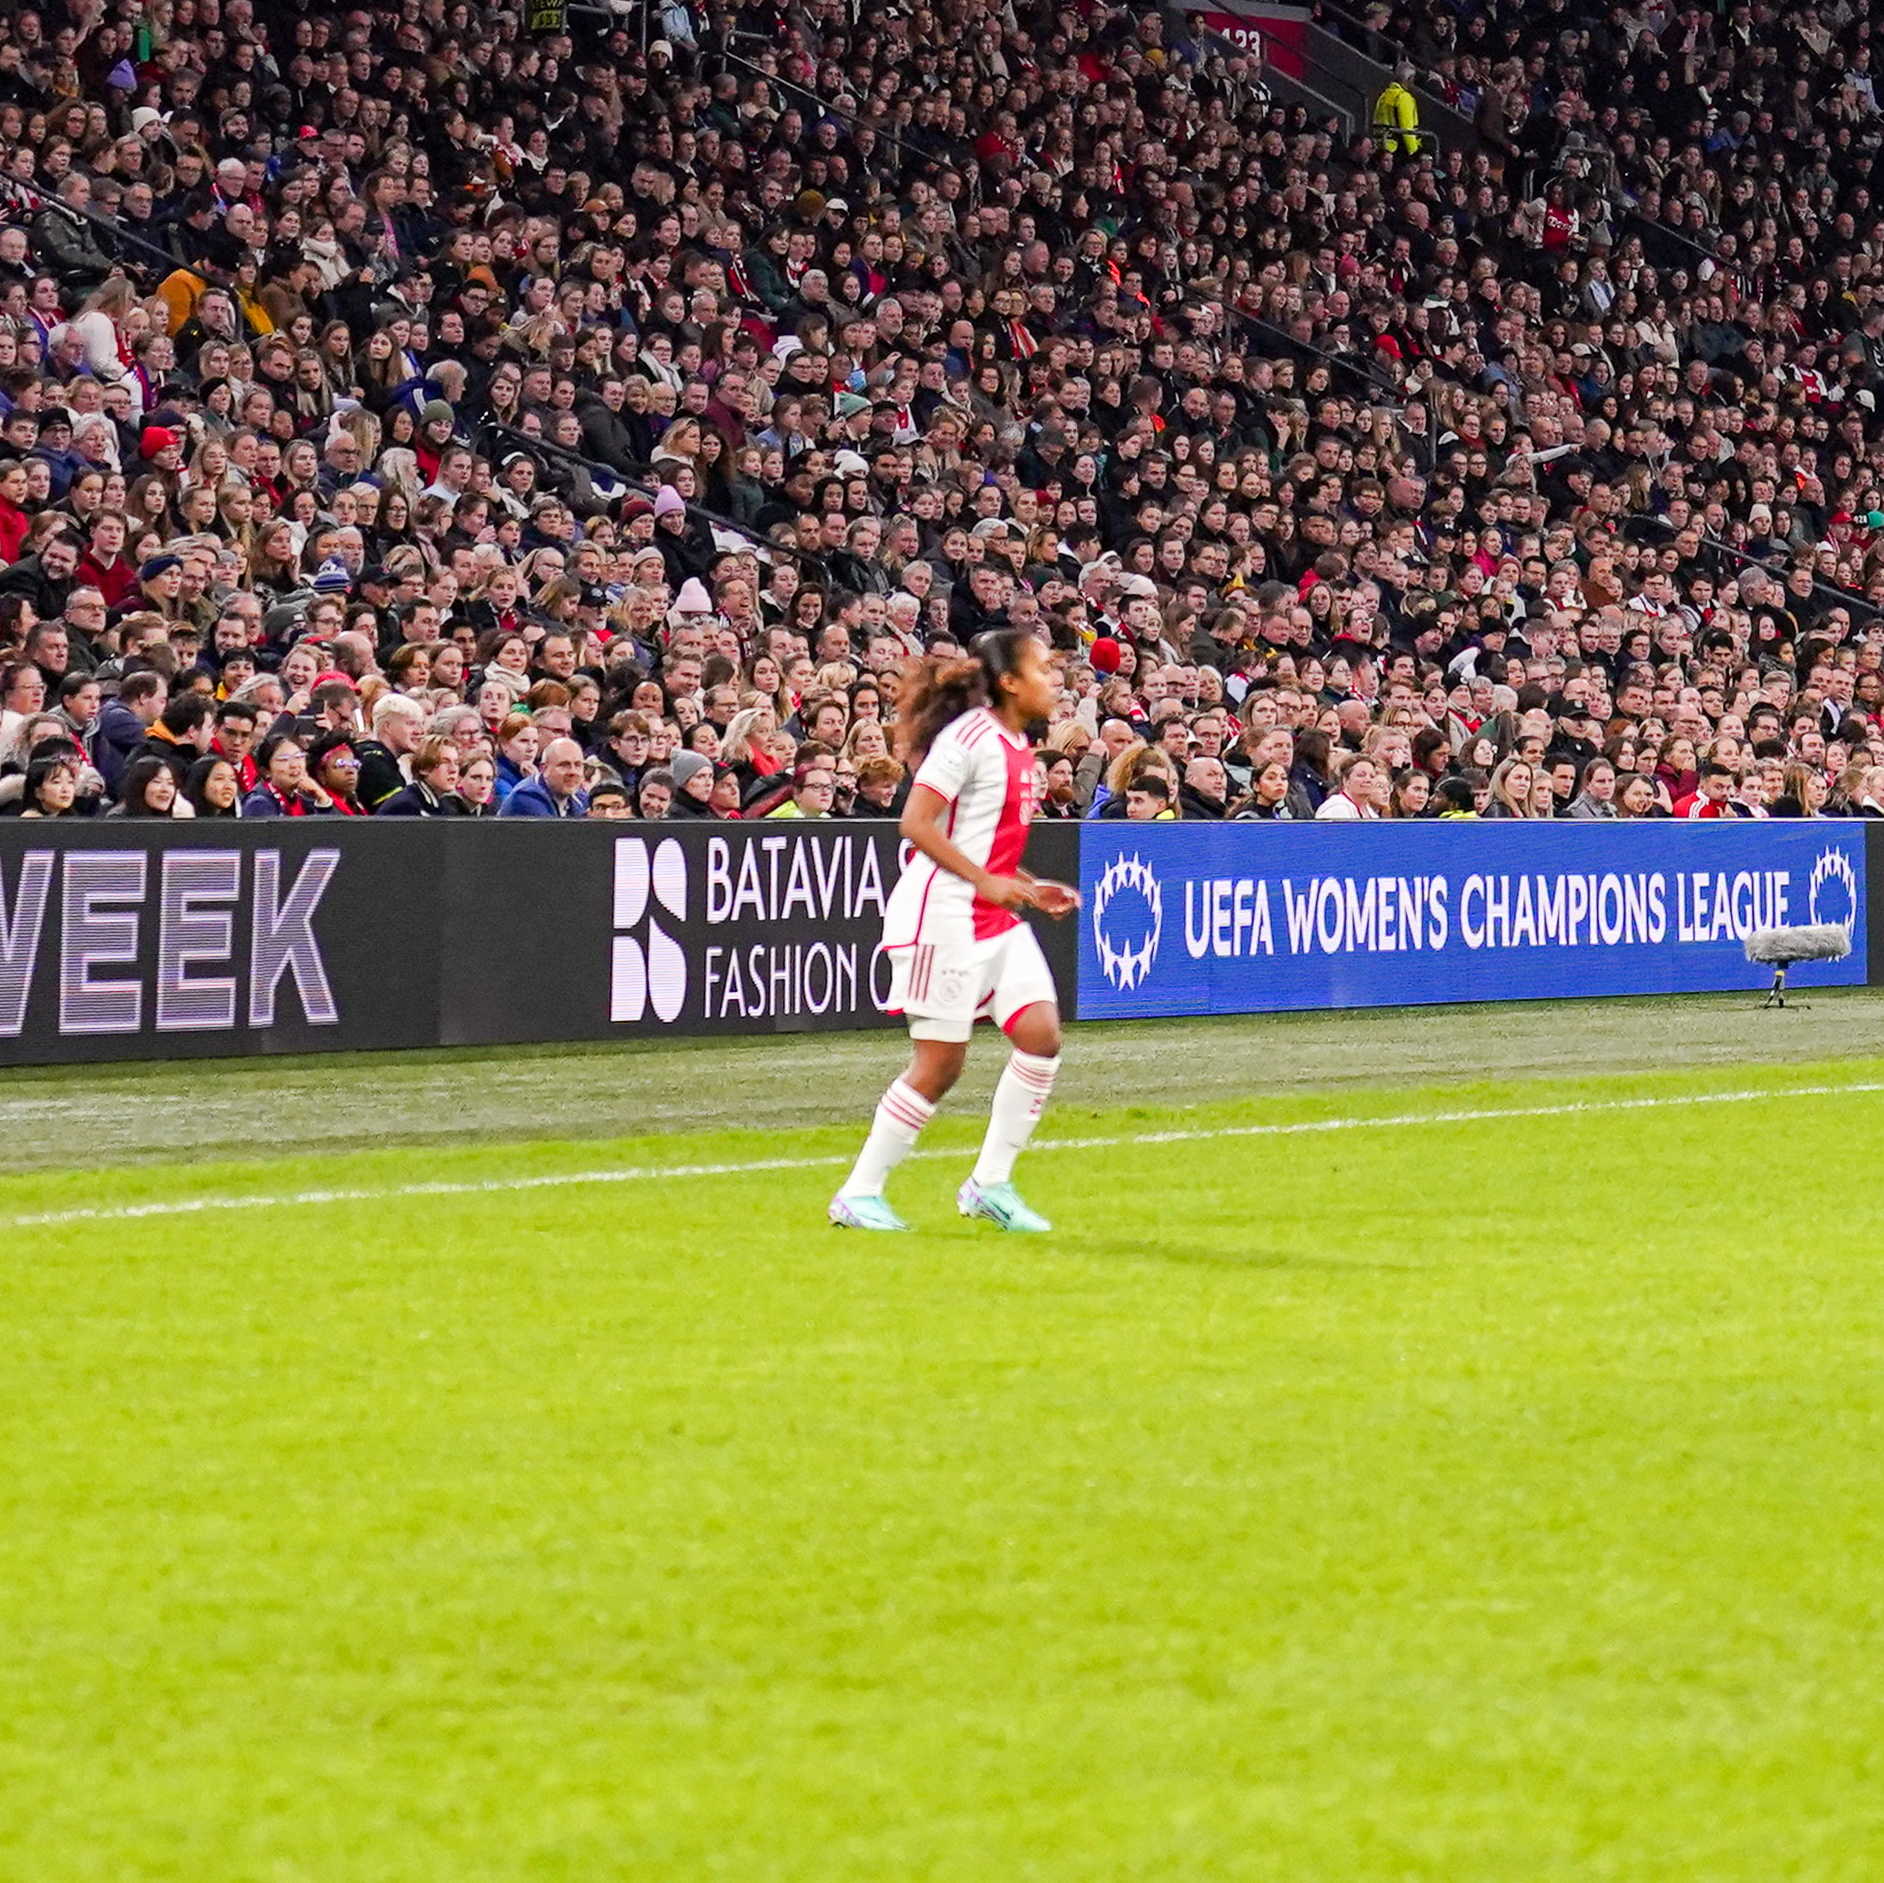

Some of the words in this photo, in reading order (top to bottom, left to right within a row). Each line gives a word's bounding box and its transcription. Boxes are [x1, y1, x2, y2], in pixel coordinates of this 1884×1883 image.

[705, 835, 886, 922] BATAVIA
[1186, 880, 1273, 958] UEFA
[1283, 876, 1447, 954] WOMEN'S
[1461, 873, 1665, 948] CHAMPIONS
[1677, 871, 1790, 943] LEAGUE
[704, 942, 857, 1019] FASHION
